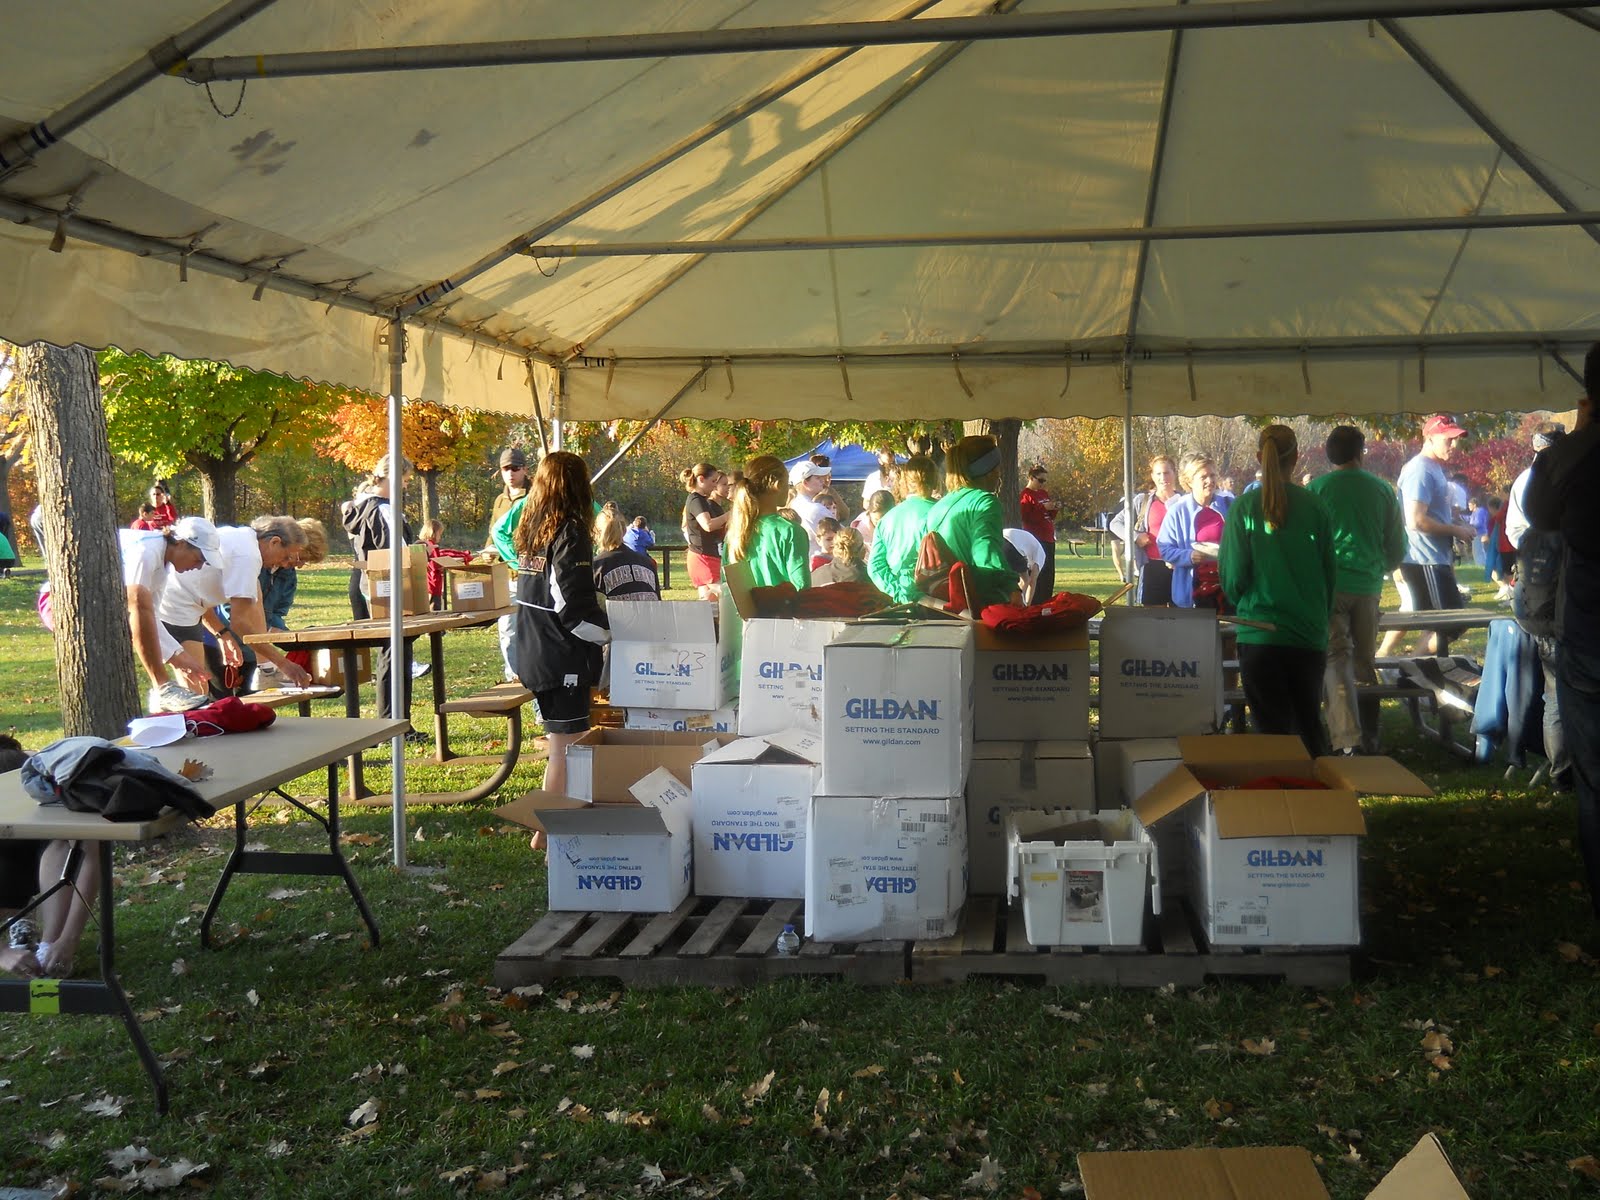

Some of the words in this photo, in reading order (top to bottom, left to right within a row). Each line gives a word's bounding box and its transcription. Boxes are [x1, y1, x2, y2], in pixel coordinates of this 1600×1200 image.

[992, 663, 1068, 680] GILDAN
[1121, 659, 1197, 677] GILDAN
[845, 698, 938, 720] GILDAN
[896, 727, 940, 735] STANDARD
[862, 737, 921, 746] www.gildan.com
[713, 832, 794, 852] GILDAN
[1247, 849, 1323, 866] GILDAN
[578, 875, 642, 890] GILDAN
[865, 876, 917, 894] GILDA
